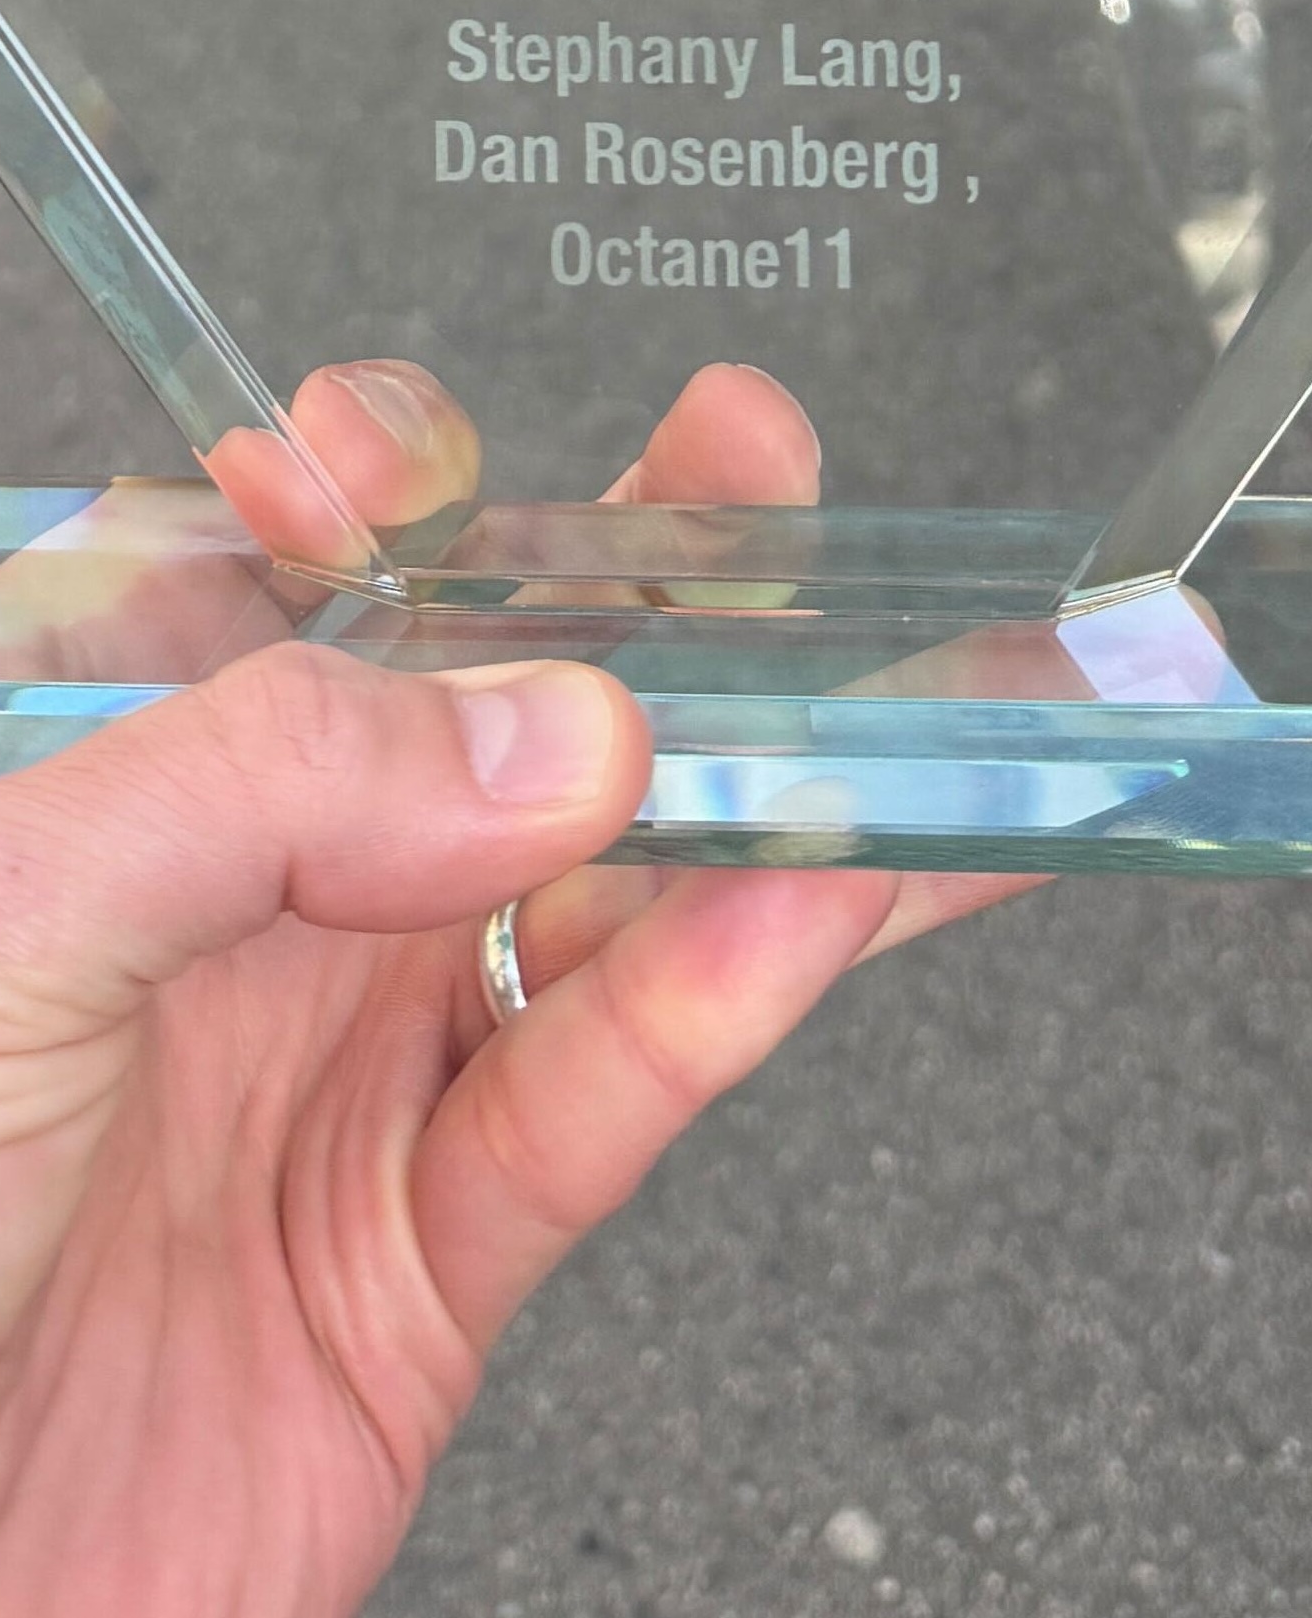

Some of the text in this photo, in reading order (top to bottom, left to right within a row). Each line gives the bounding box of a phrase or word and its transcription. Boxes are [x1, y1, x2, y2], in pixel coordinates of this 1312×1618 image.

[447, 18, 962, 104] Stephany Lang,
[435, 120, 559, 184] Dan
[585, 122, 939, 205] Rosenberg
[551, 221, 852, 290] Octane11
